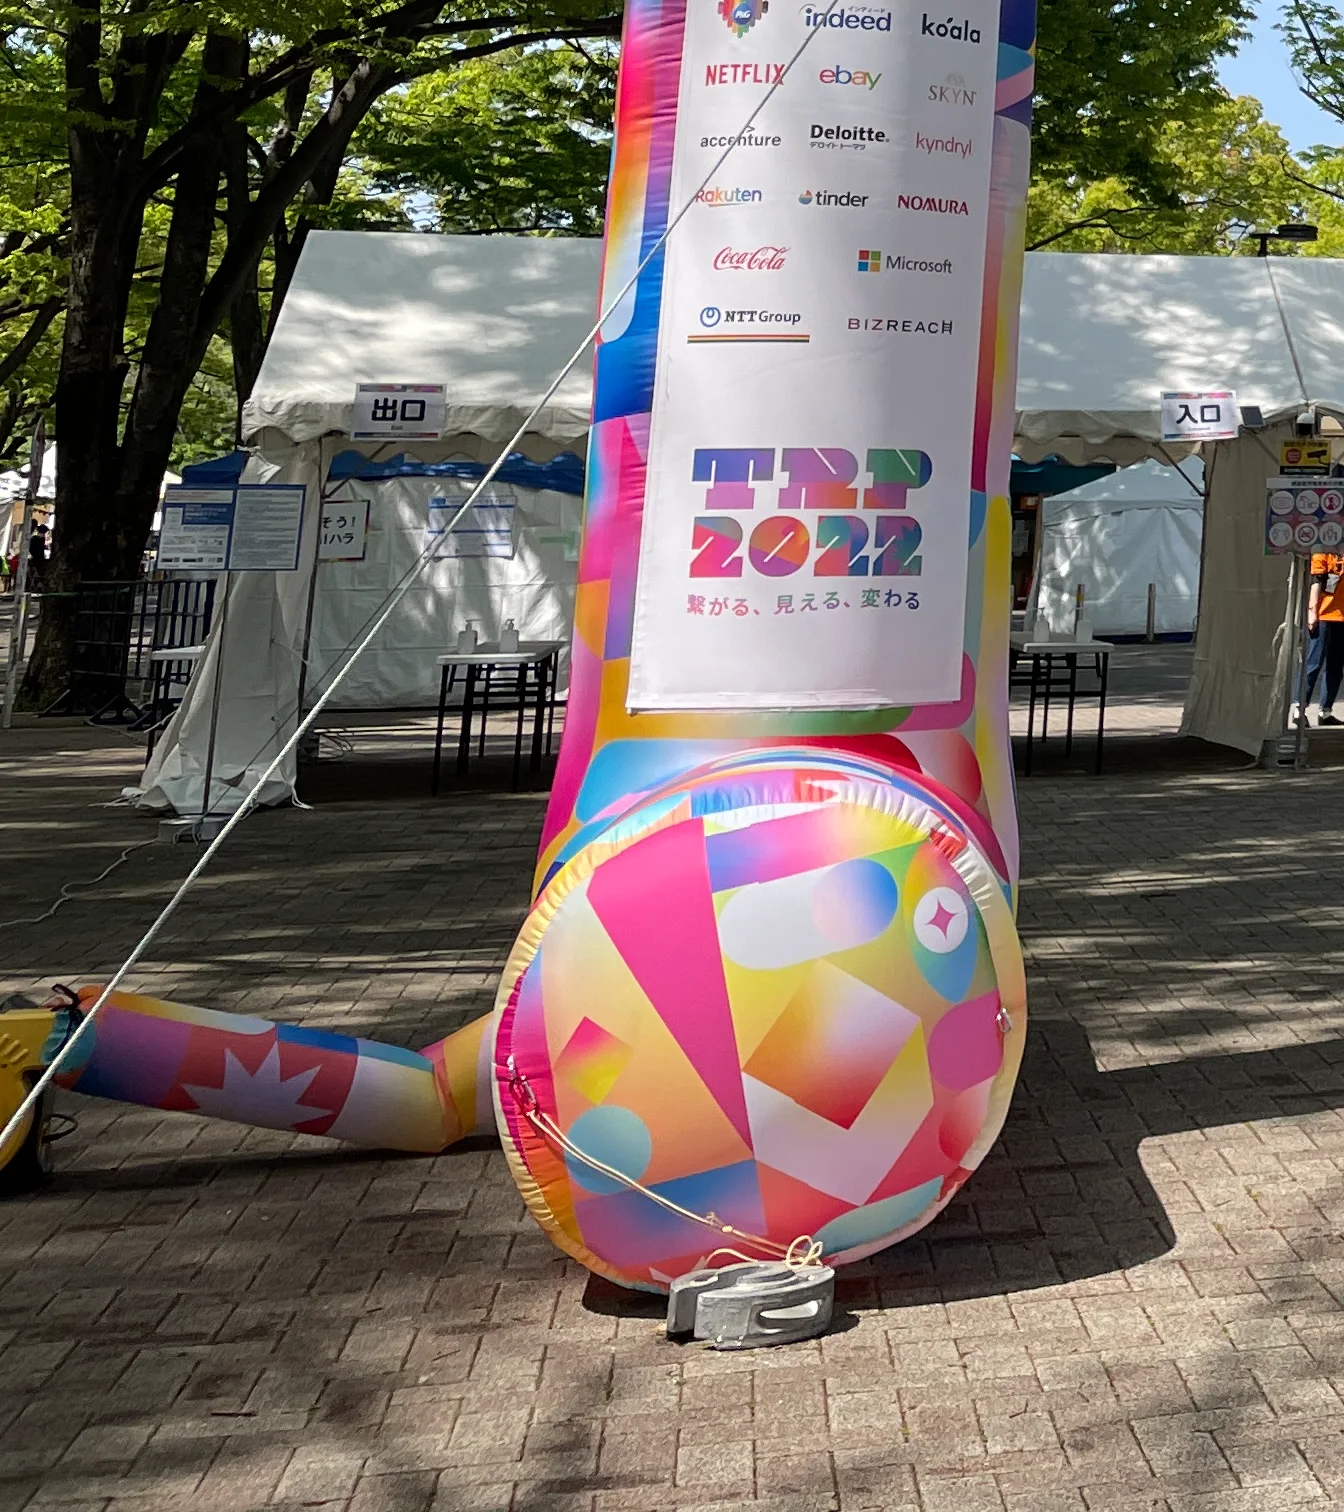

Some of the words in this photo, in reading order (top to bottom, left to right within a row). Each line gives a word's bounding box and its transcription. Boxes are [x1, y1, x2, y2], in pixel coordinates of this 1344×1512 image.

[805, 7, 892, 32] indeed
[705, 63, 785, 87] NETFLIX
[819, 65, 883, 91] ebay
[700, 133, 782, 148] accenture
[916, 132, 972, 160] kyndryl
[695, 187, 762, 204] Rakuten
[815, 190, 868, 208] tinder
[897, 195, 969, 216] NOMURA
[885, 255, 952, 274] Microsoft
[848, 318, 953, 335] BIZREACH
[371, 397, 426, 421] 出口
[1175, 404, 1221, 424] 入口
[692, 447, 933, 510] TRP
[689, 515, 923, 578] 2022
[686, 588, 920, 617] 繋がる、見える、変わる
